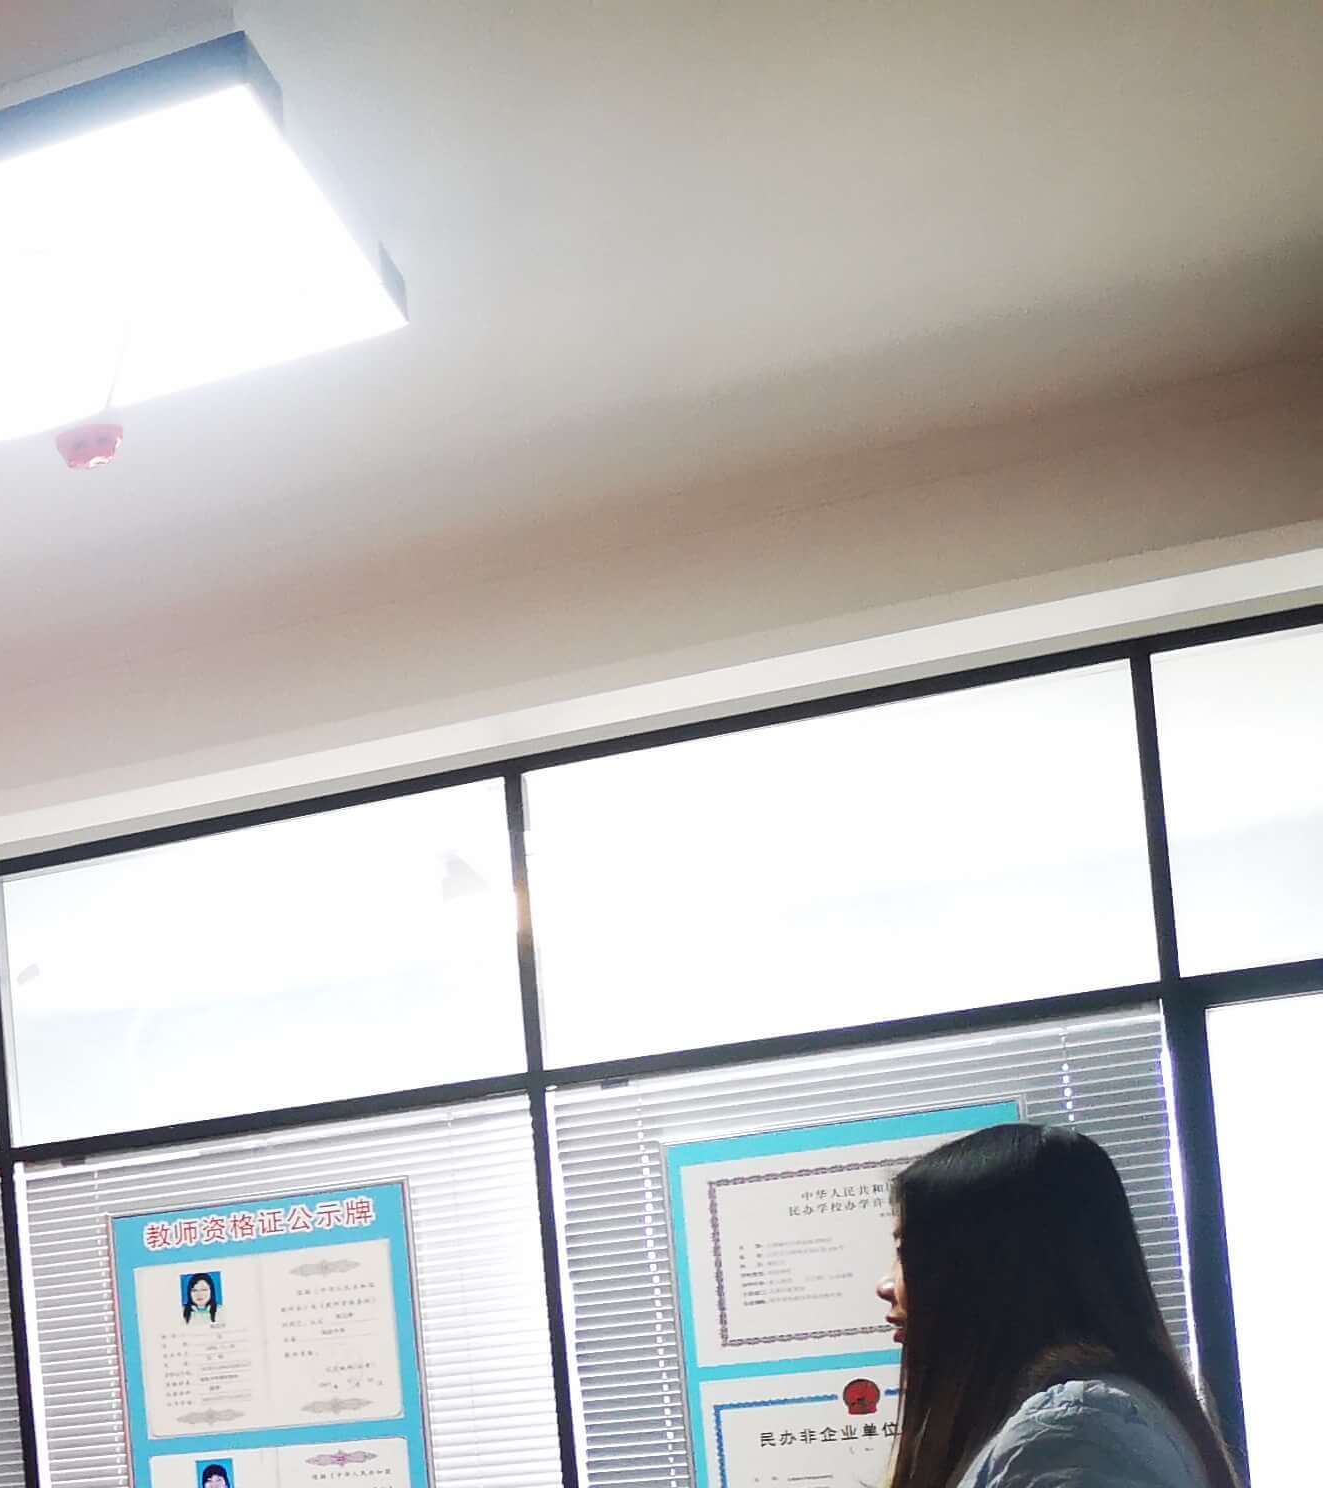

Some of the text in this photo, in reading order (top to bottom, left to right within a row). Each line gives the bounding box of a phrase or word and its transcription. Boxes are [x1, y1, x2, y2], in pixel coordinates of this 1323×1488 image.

[801, 1183, 892, 1200] 中华人民共和
[146, 1198, 373, 1248] 教师资格证公示牌
[760, 1422, 902, 1447] 民办非企业单位
